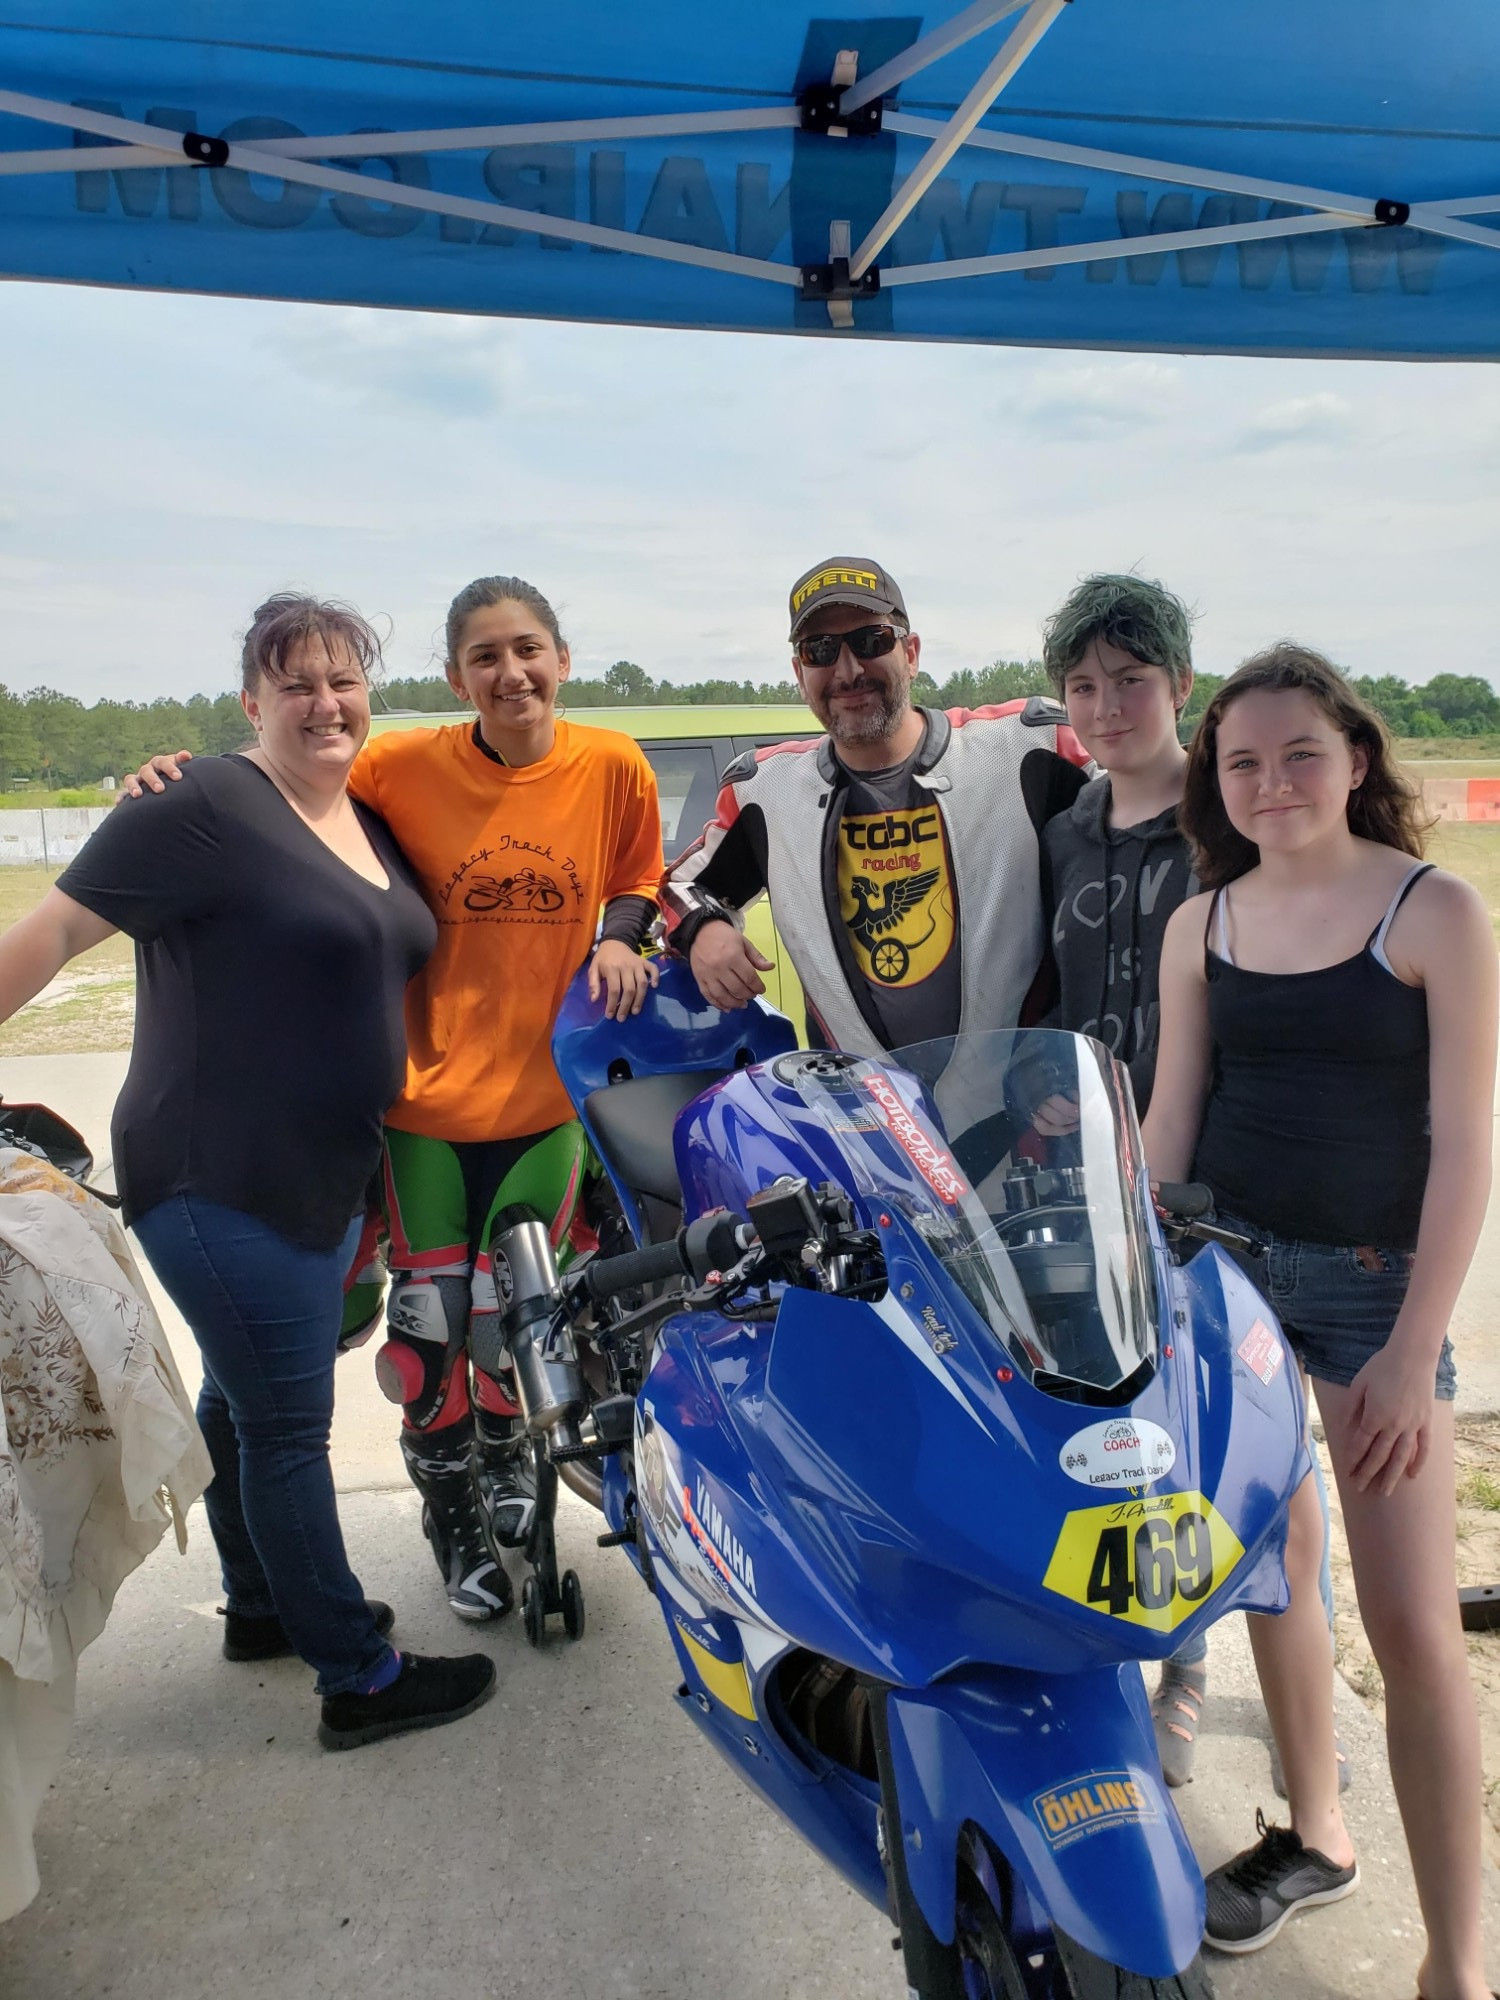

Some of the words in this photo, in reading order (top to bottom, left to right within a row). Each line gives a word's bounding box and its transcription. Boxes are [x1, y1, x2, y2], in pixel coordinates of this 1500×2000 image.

[793, 567, 877, 613] PIRELLI
[439, 848, 494, 906] Legacy
[500, 835, 555, 861] Track
[861, 853, 921, 871] racing
[1106, 943, 1142, 985] is
[867, 1076, 964, 1194] HOTBODIES
[1103, 1437, 1141, 1452] COACH
[1089, 1472, 1120, 1484] Legacy
[1122, 1467, 1146, 1479] Track
[696, 1475, 758, 1597] YAMAHA
[1086, 1511, 1214, 1616] 469
[1040, 1781, 1147, 1832] ÖHLINS
